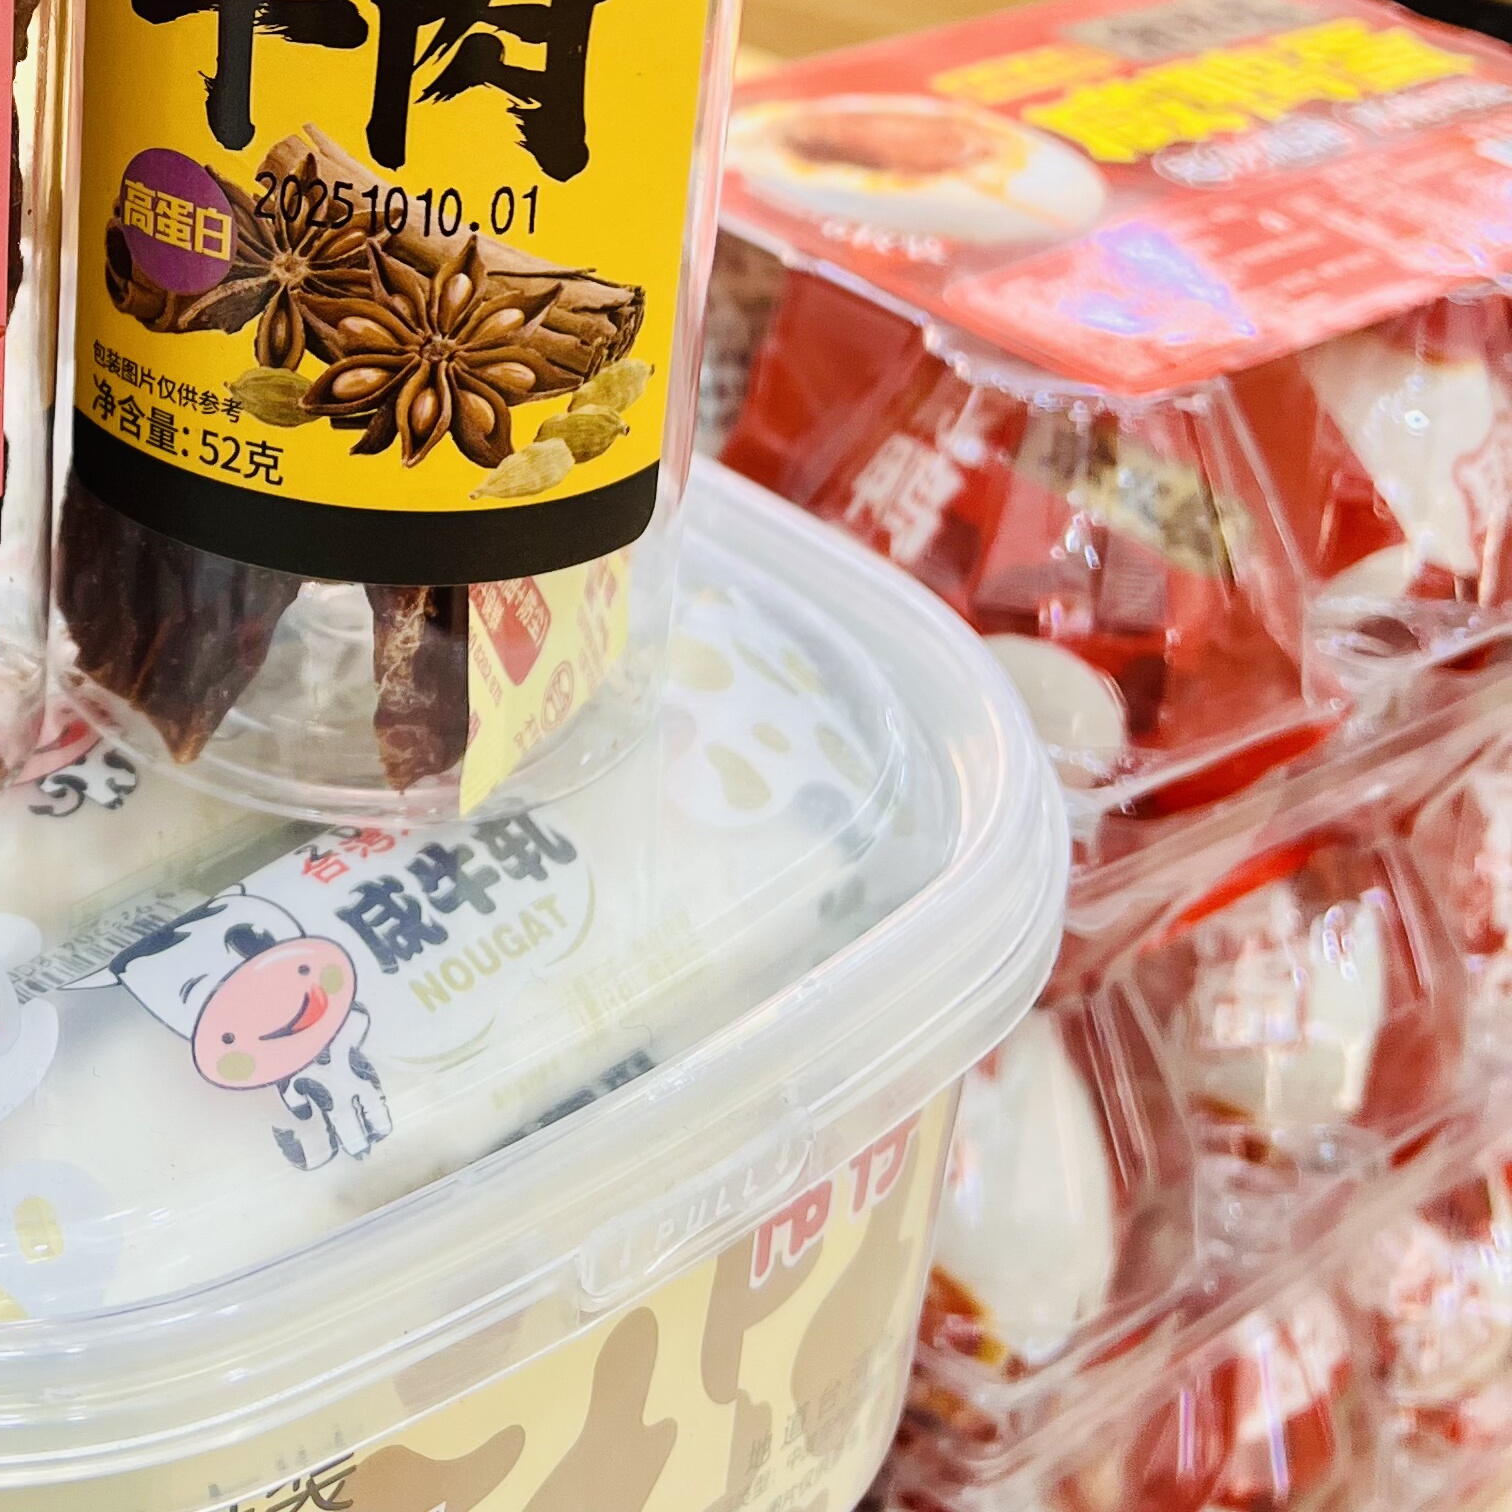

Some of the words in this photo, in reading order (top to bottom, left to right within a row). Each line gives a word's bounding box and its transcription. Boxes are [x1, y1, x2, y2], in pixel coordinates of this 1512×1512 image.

[123, 178, 233, 261] 高蛋白
[253, 170, 539, 237] 20251010.01
[93, 339, 245, 423] 包装图片仅供参考
[408, 893, 569, 1013] NOUGAT
